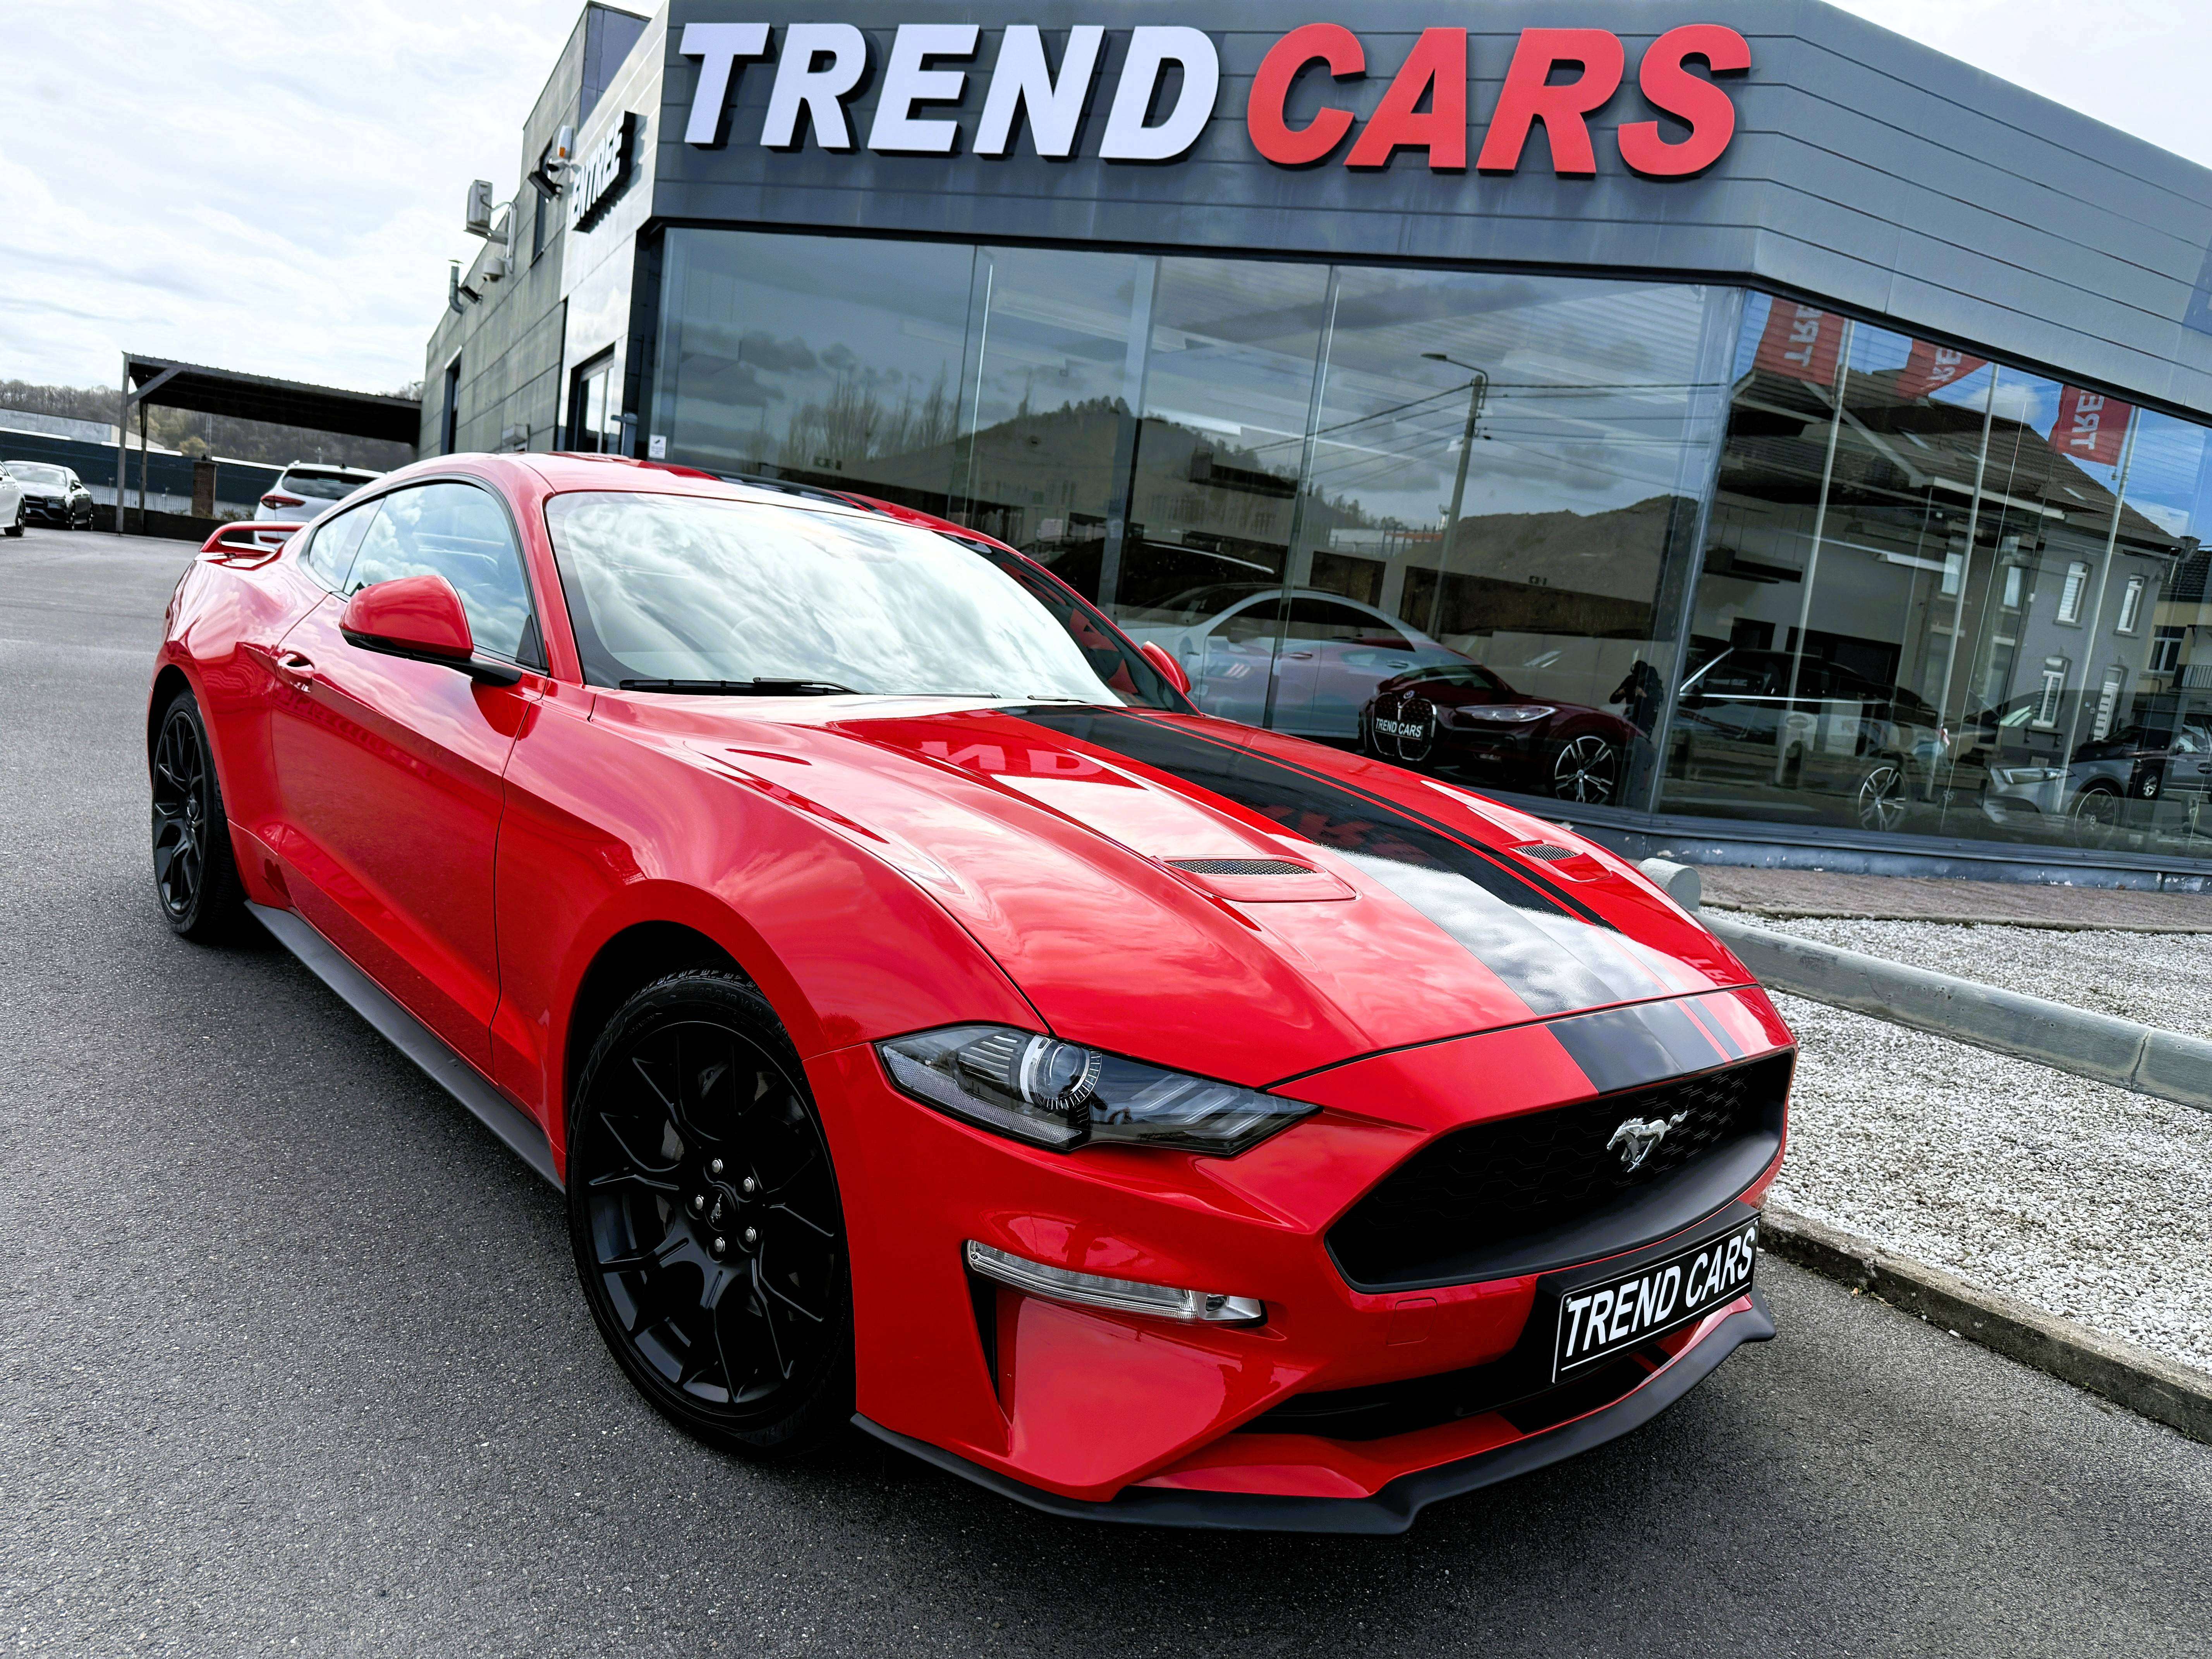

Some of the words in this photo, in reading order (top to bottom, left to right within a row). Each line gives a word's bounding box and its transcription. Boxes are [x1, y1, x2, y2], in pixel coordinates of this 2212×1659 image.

[679, 22, 1219, 160] TREND
[1247, 22, 1751, 175] CARS
[1375, 717, 1398, 734] TREND
[1398, 722, 1423, 738] CARS
[1566, 1265, 1681, 1357] TREND
[1685, 1227, 1756, 1308] CARS
